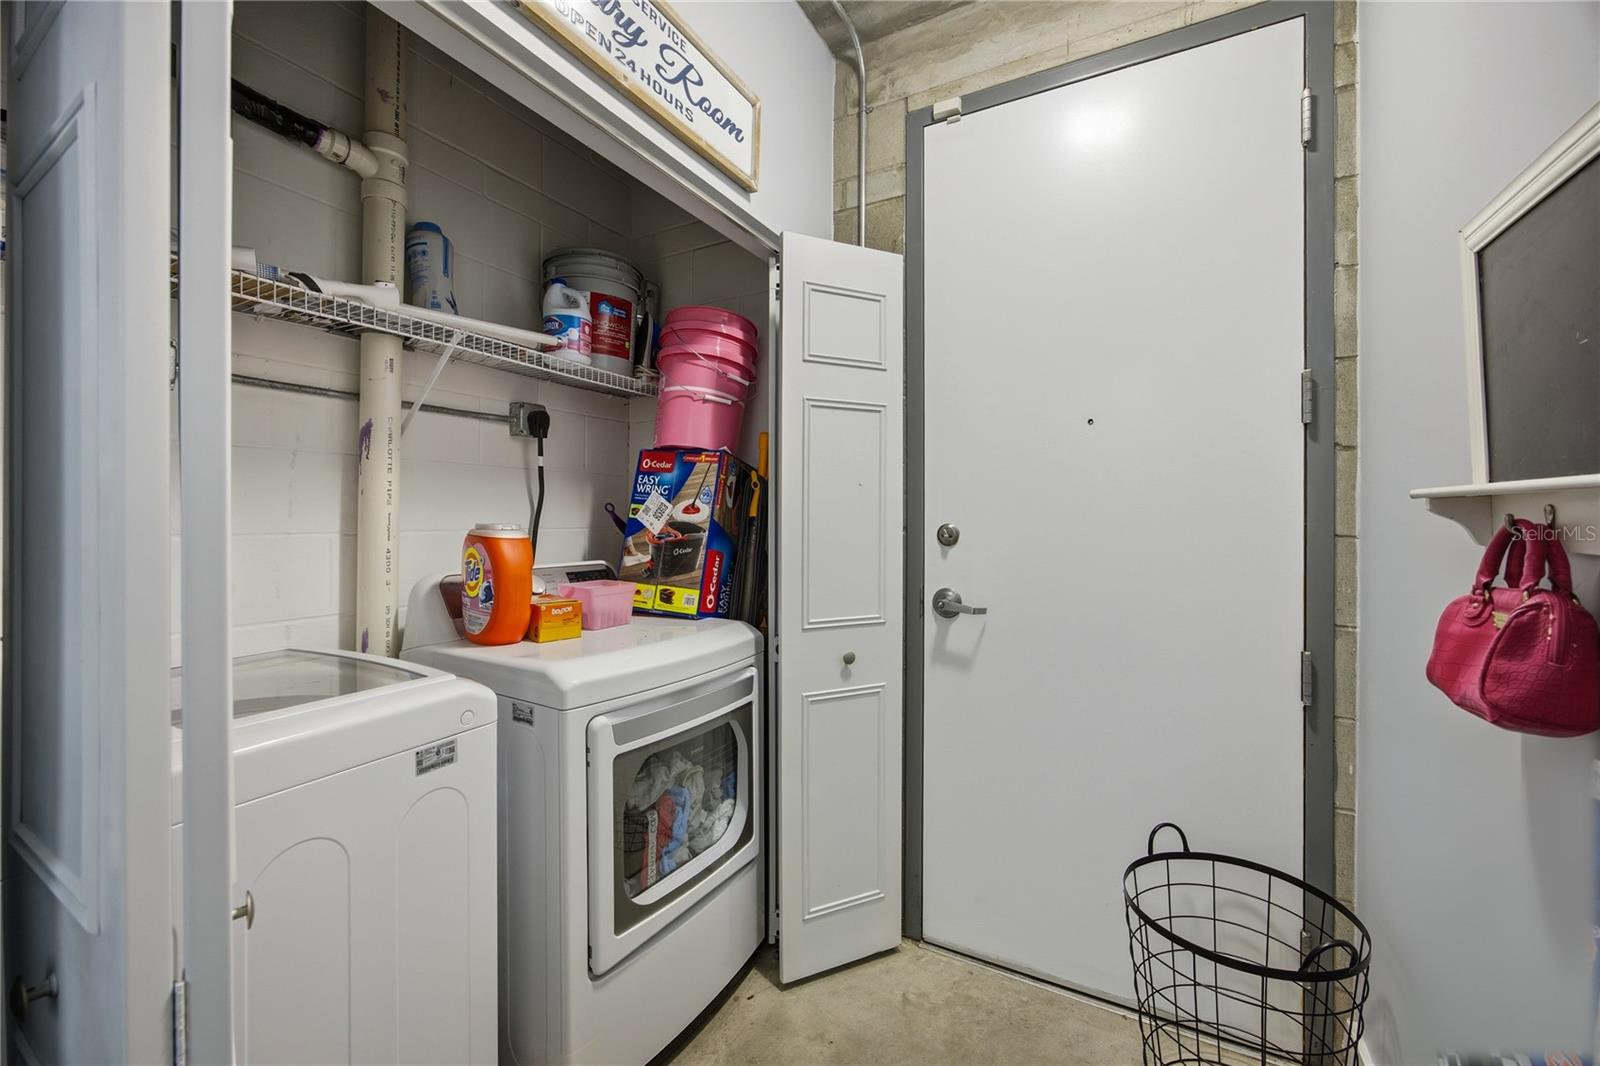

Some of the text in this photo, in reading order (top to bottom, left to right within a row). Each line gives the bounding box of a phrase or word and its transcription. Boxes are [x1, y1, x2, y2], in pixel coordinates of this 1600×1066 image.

[555, 0, 694, 123] OPEN 24 HOURS
[655, 43, 744, 143] Room
[642, 458, 673, 469] O-Cedar
[637, 484, 669, 495] WRING
[638, 474, 661, 485] EASY
[465, 559, 481, 581] Tide
[706, 554, 720, 609] O-Cedar
